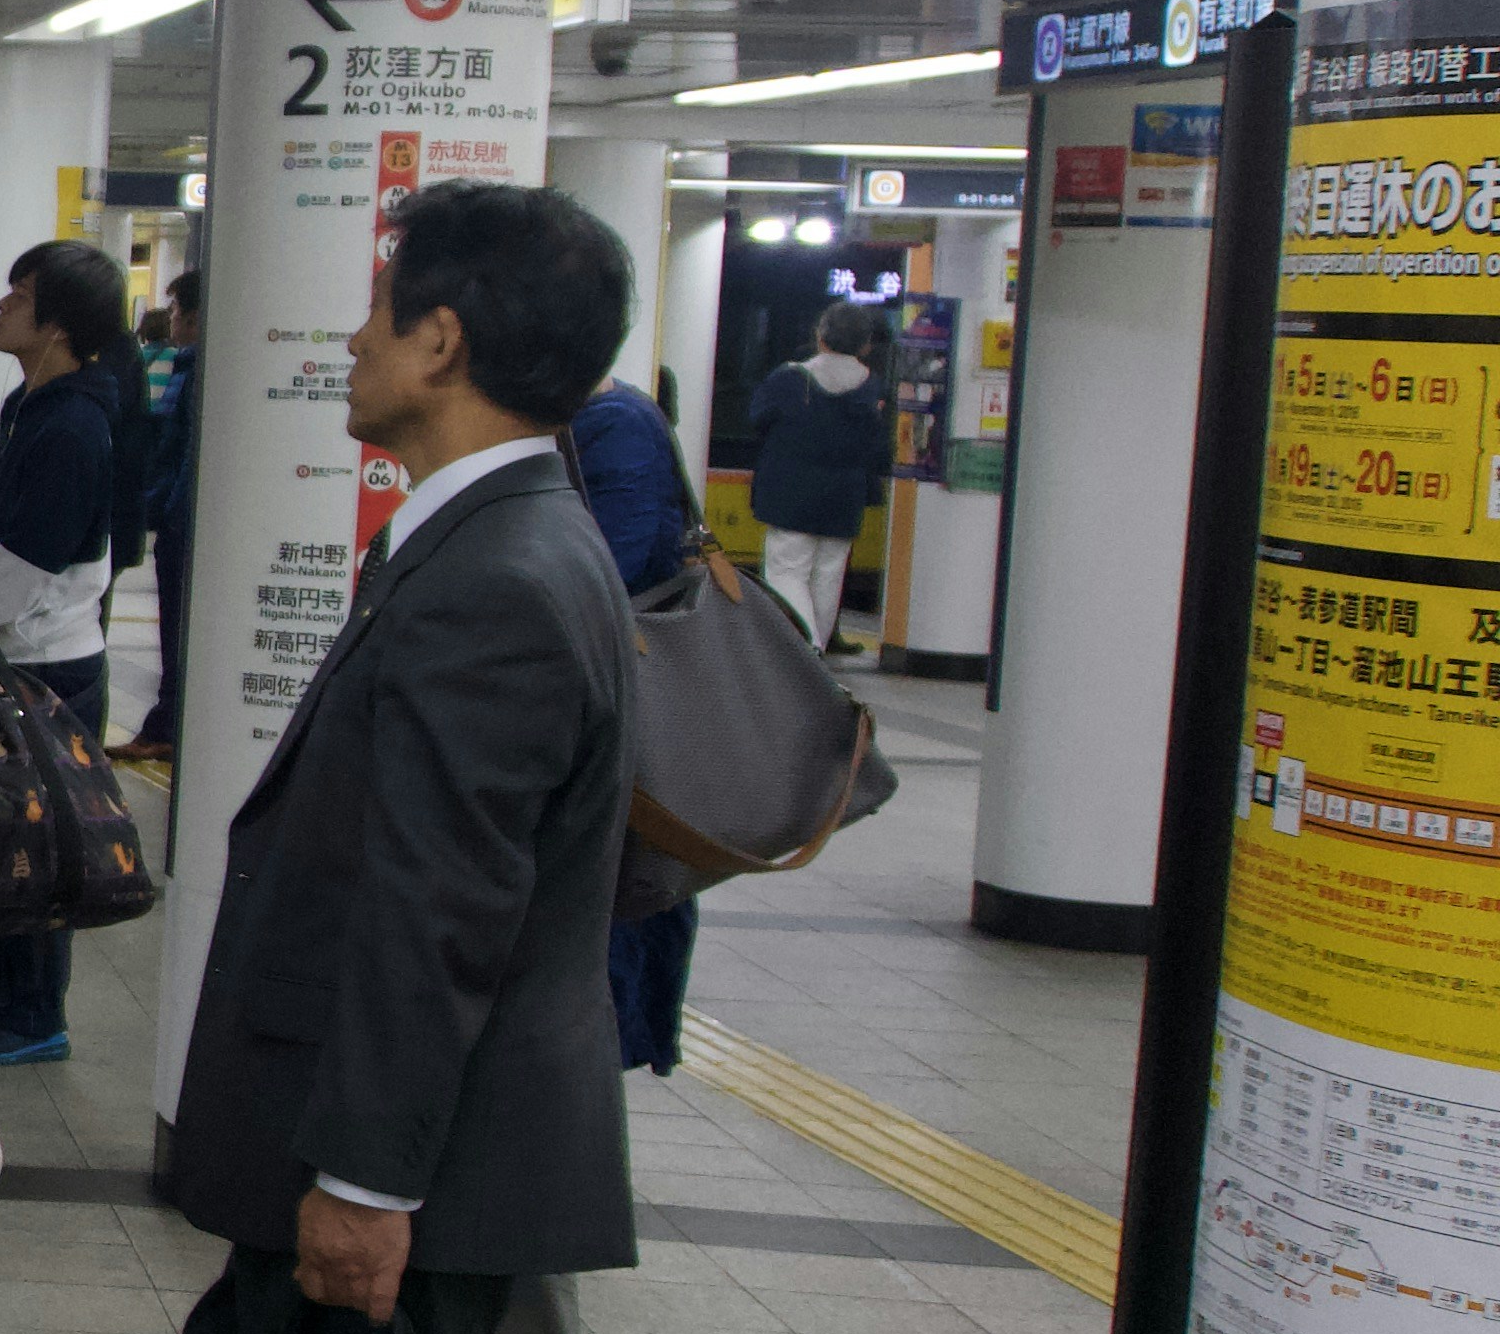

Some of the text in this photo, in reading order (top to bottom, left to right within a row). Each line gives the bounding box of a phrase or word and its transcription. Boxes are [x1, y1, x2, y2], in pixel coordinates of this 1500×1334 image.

[346, 46, 494, 80] 荻窪方面
[284, 45, 328, 115] 2
[344, 82, 466, 100] for Ogikubo
[391, 153, 411, 167] 13
[426, 141, 507, 164] 赤坂見附
[1384, 245, 1480, 282] operation
[375, 460, 387, 470] M
[368, 472, 391, 486] 06
[279, 542, 347, 566] 新中野
[270, 564, 346, 578] Shin-Nakano
[258, 585, 344, 611] 東高円寺
[261, 609, 344, 626] Higashi-koenji
